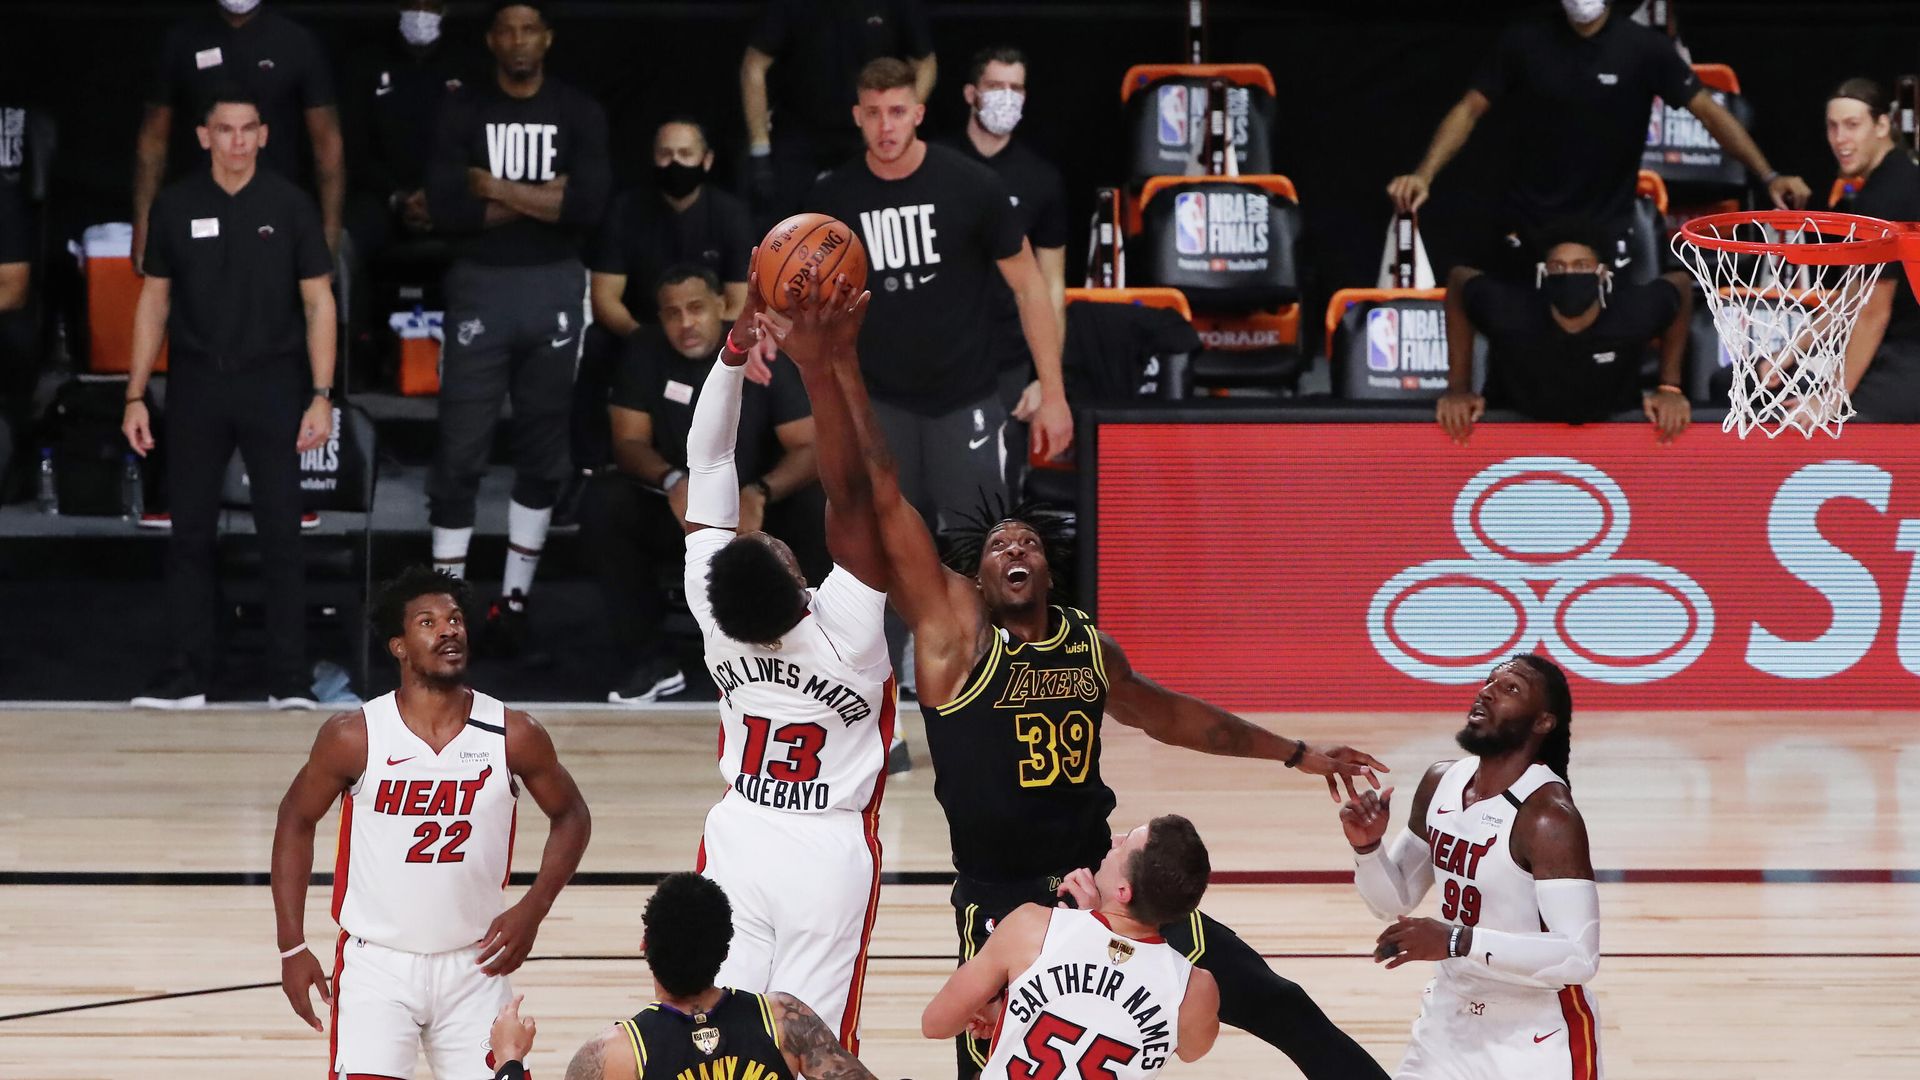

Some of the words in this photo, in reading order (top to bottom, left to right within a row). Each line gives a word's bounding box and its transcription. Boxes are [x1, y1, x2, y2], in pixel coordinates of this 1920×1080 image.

[486, 123, 558, 180] VOTE
[1208, 193, 1244, 222] NBA
[770, 240, 782, 252] 20
[860, 204, 941, 271] VOTE
[1208, 223, 1268, 254] FINALS
[1401, 309, 1439, 339] NBA
[1065, 641, 1089, 654] wish
[740, 656, 801, 689] LIVES
[802, 675, 872, 728] MATTER
[993, 662, 1099, 708] LAKERS
[741, 713, 828, 783] 13
[1015, 710, 1094, 788] 39
[374, 764, 493, 816] HEAT
[735, 774, 829, 811] ADEBAYO
[405, 820, 473, 864] 22
[1428, 825, 1497, 880] HEAT
[1442, 878, 1482, 928] 99
[1009, 974, 1049, 1024] SAY
[1047, 963, 1125, 1001] THEIR
[1121, 985, 1170, 1071] NAMES
[1005, 1010, 1141, 1080] 55
